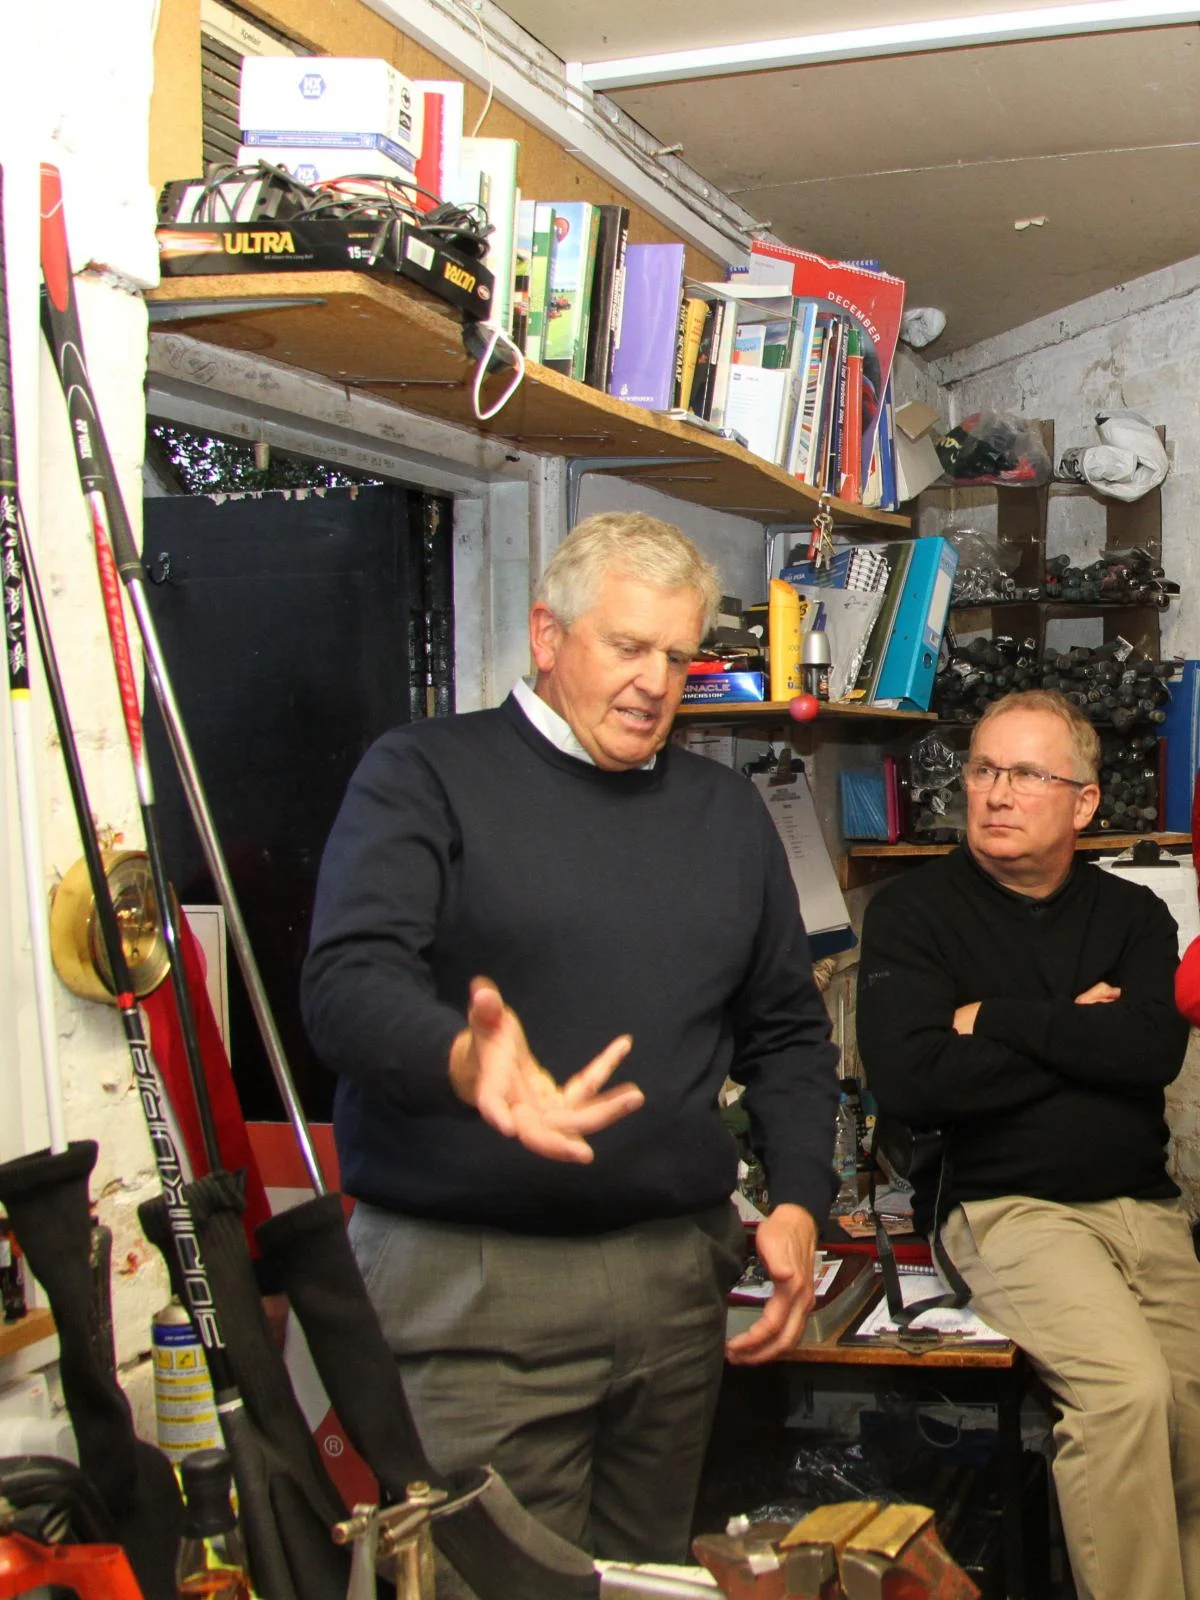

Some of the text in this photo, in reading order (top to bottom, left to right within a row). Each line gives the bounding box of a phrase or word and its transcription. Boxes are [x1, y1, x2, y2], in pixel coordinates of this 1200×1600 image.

[224, 231, 295, 254] ULTRA
[347, 246, 361, 259] 15
[444, 261, 476, 293] ULTRA
[827, 291, 881, 344] DECEMBER
